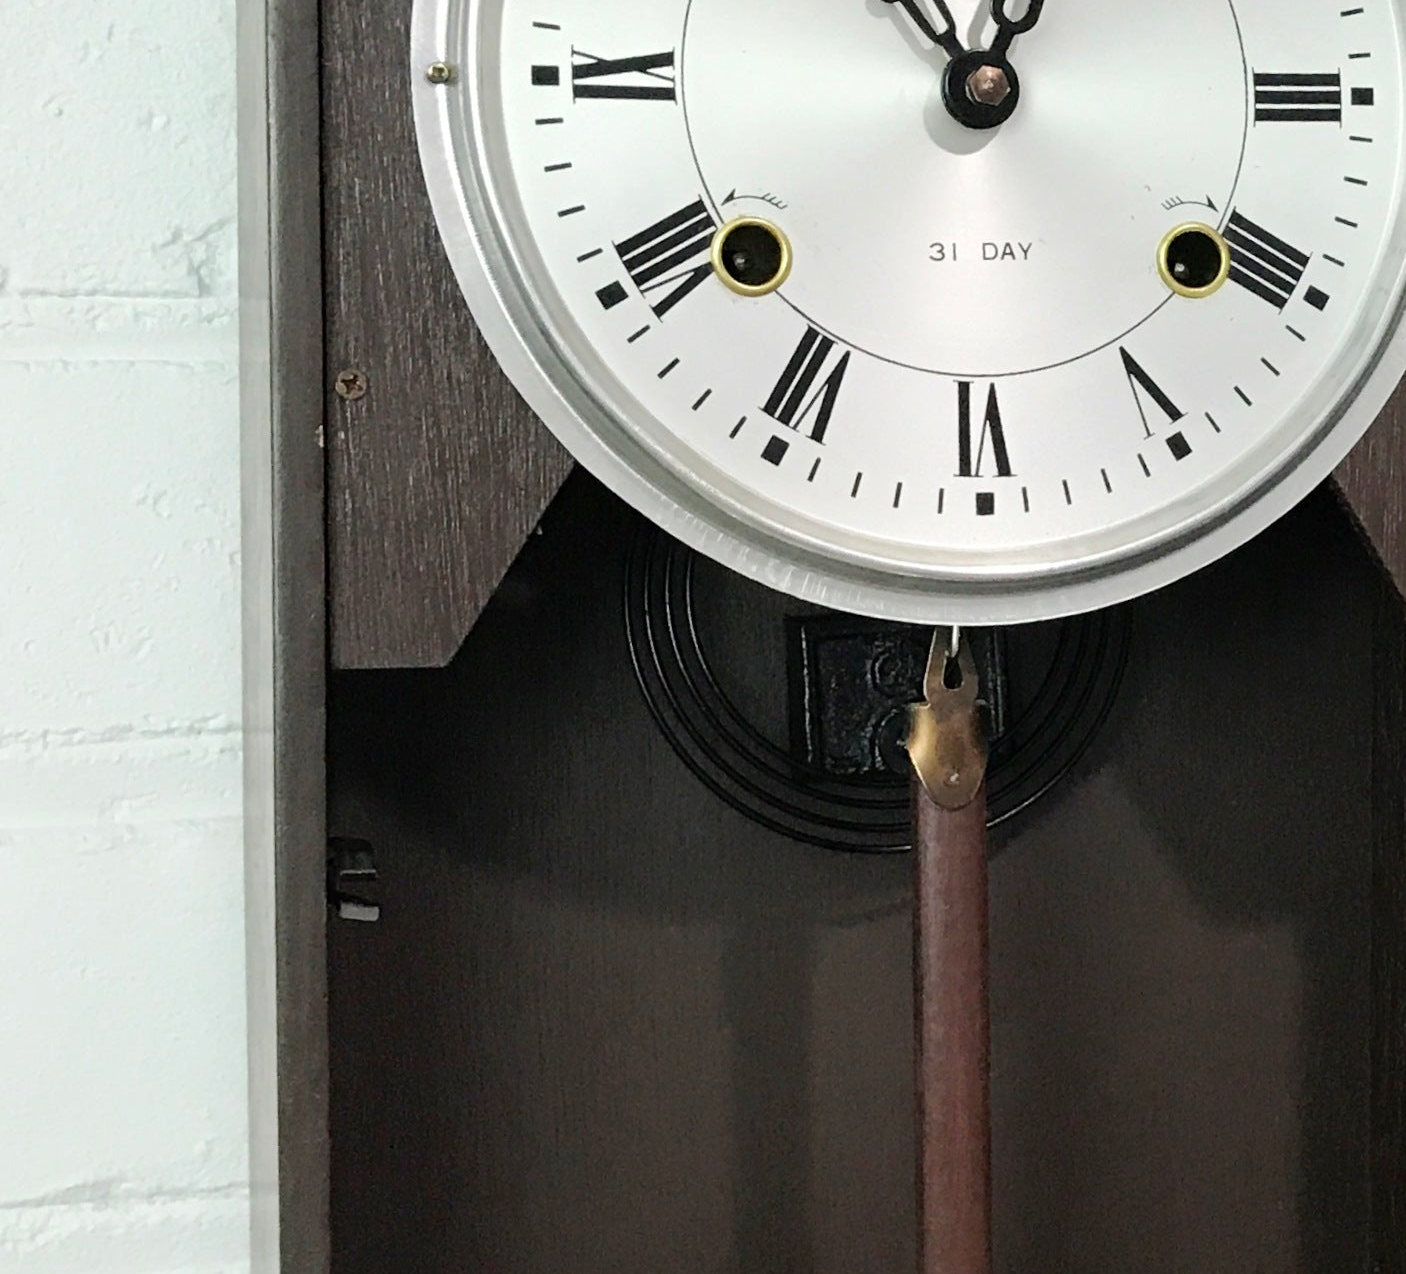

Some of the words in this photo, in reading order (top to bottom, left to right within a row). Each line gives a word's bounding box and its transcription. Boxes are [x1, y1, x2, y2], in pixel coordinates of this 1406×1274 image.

[571, 45, 677, 104] IX
[1253, 67, 1343, 127] III
[929, 242, 958, 262] 31
[983, 242, 1033, 262] DAY
[760, 324, 850, 444] VII
[1119, 344, 1187, 438] V
[953, 379, 1015, 478] VI
